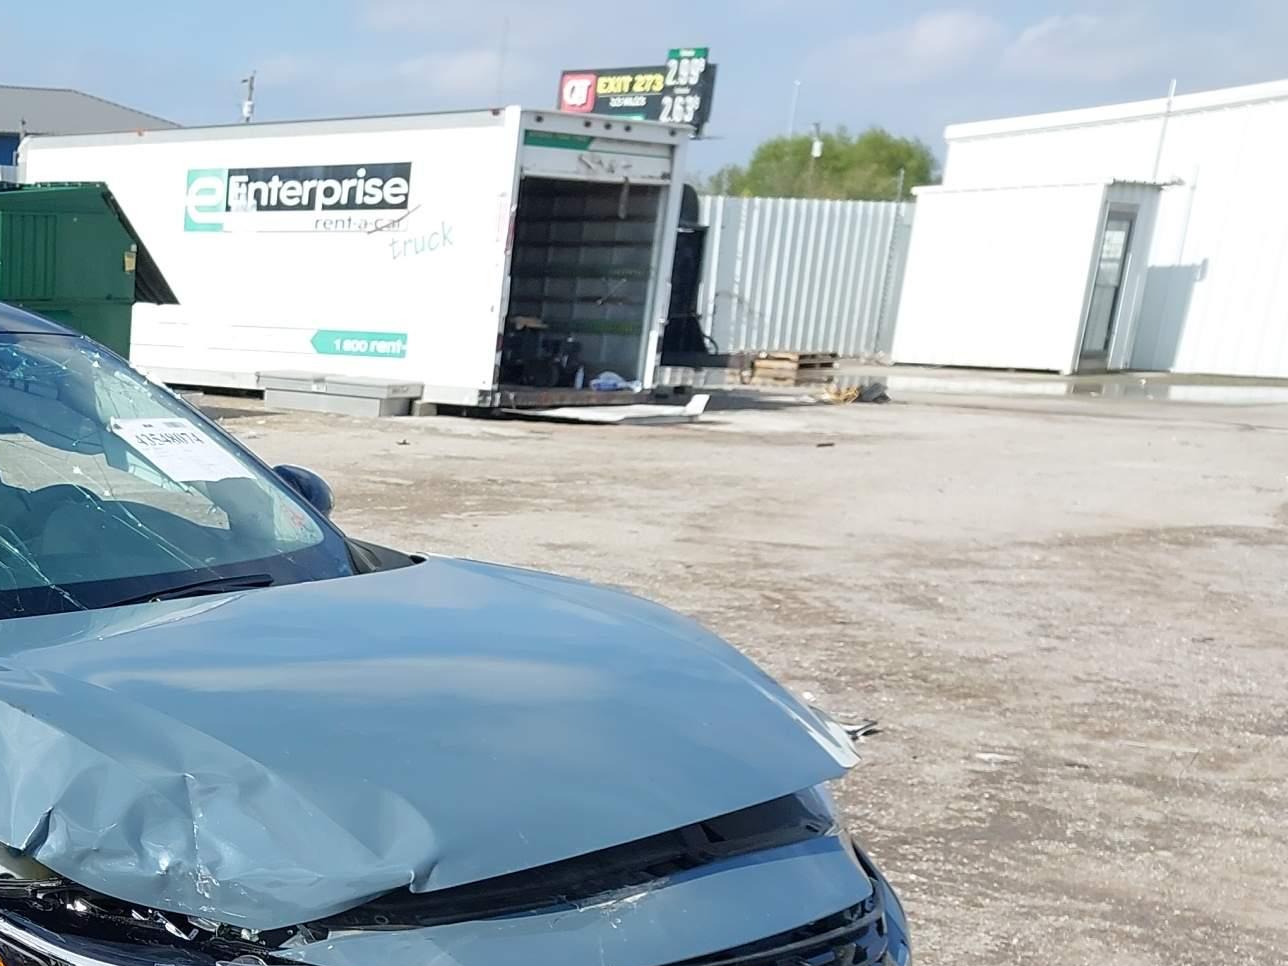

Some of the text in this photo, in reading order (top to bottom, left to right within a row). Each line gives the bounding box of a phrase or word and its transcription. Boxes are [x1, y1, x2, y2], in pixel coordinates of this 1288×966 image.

[596, 73, 665, 94] EXIT 273
[227, 167, 409, 213] Enterprise
[389, 221, 454, 260] truck
